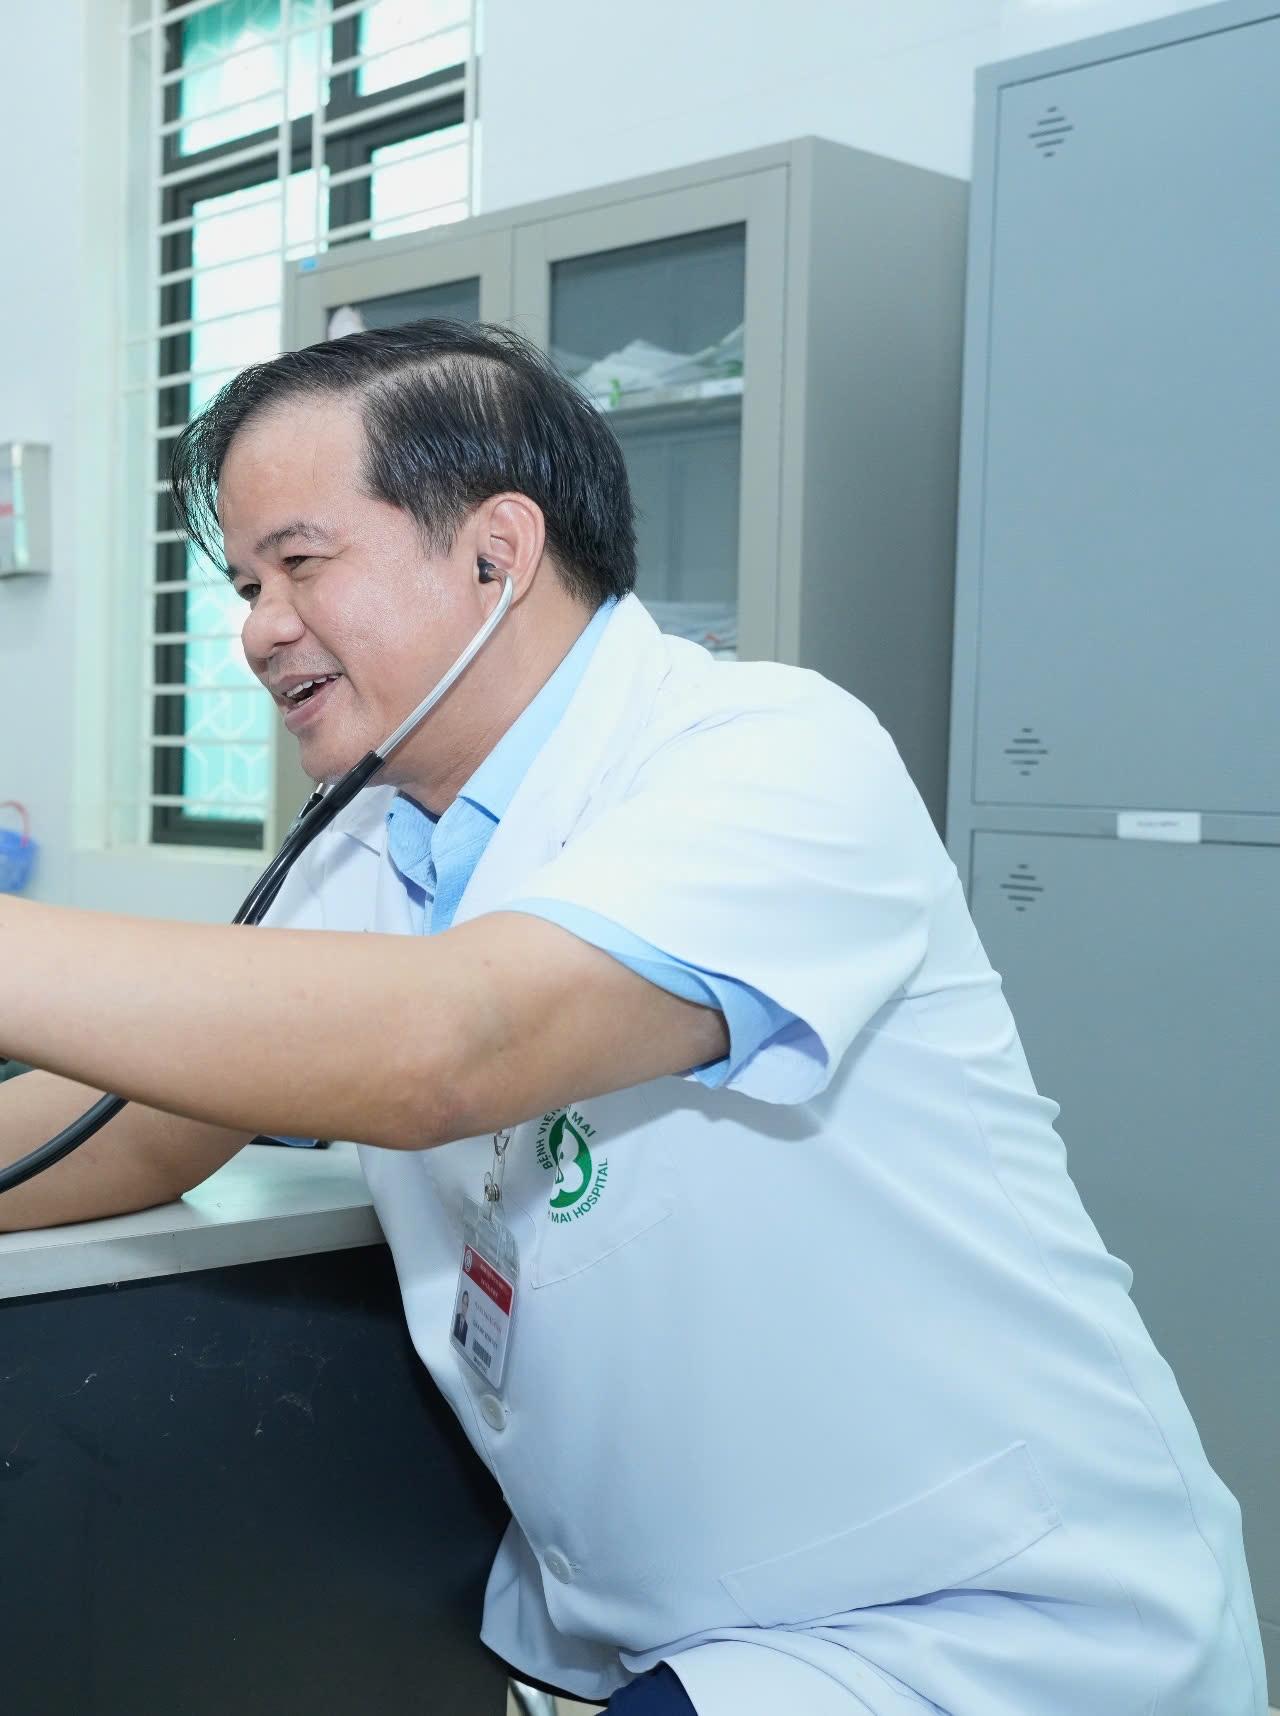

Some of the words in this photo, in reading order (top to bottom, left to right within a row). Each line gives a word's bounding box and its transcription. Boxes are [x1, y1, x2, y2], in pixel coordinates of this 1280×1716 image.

[571, 1111, 596, 1138] MAI
[551, 1210, 572, 1224] MAI
[572, 1158, 608, 1218] HOSPITAL
